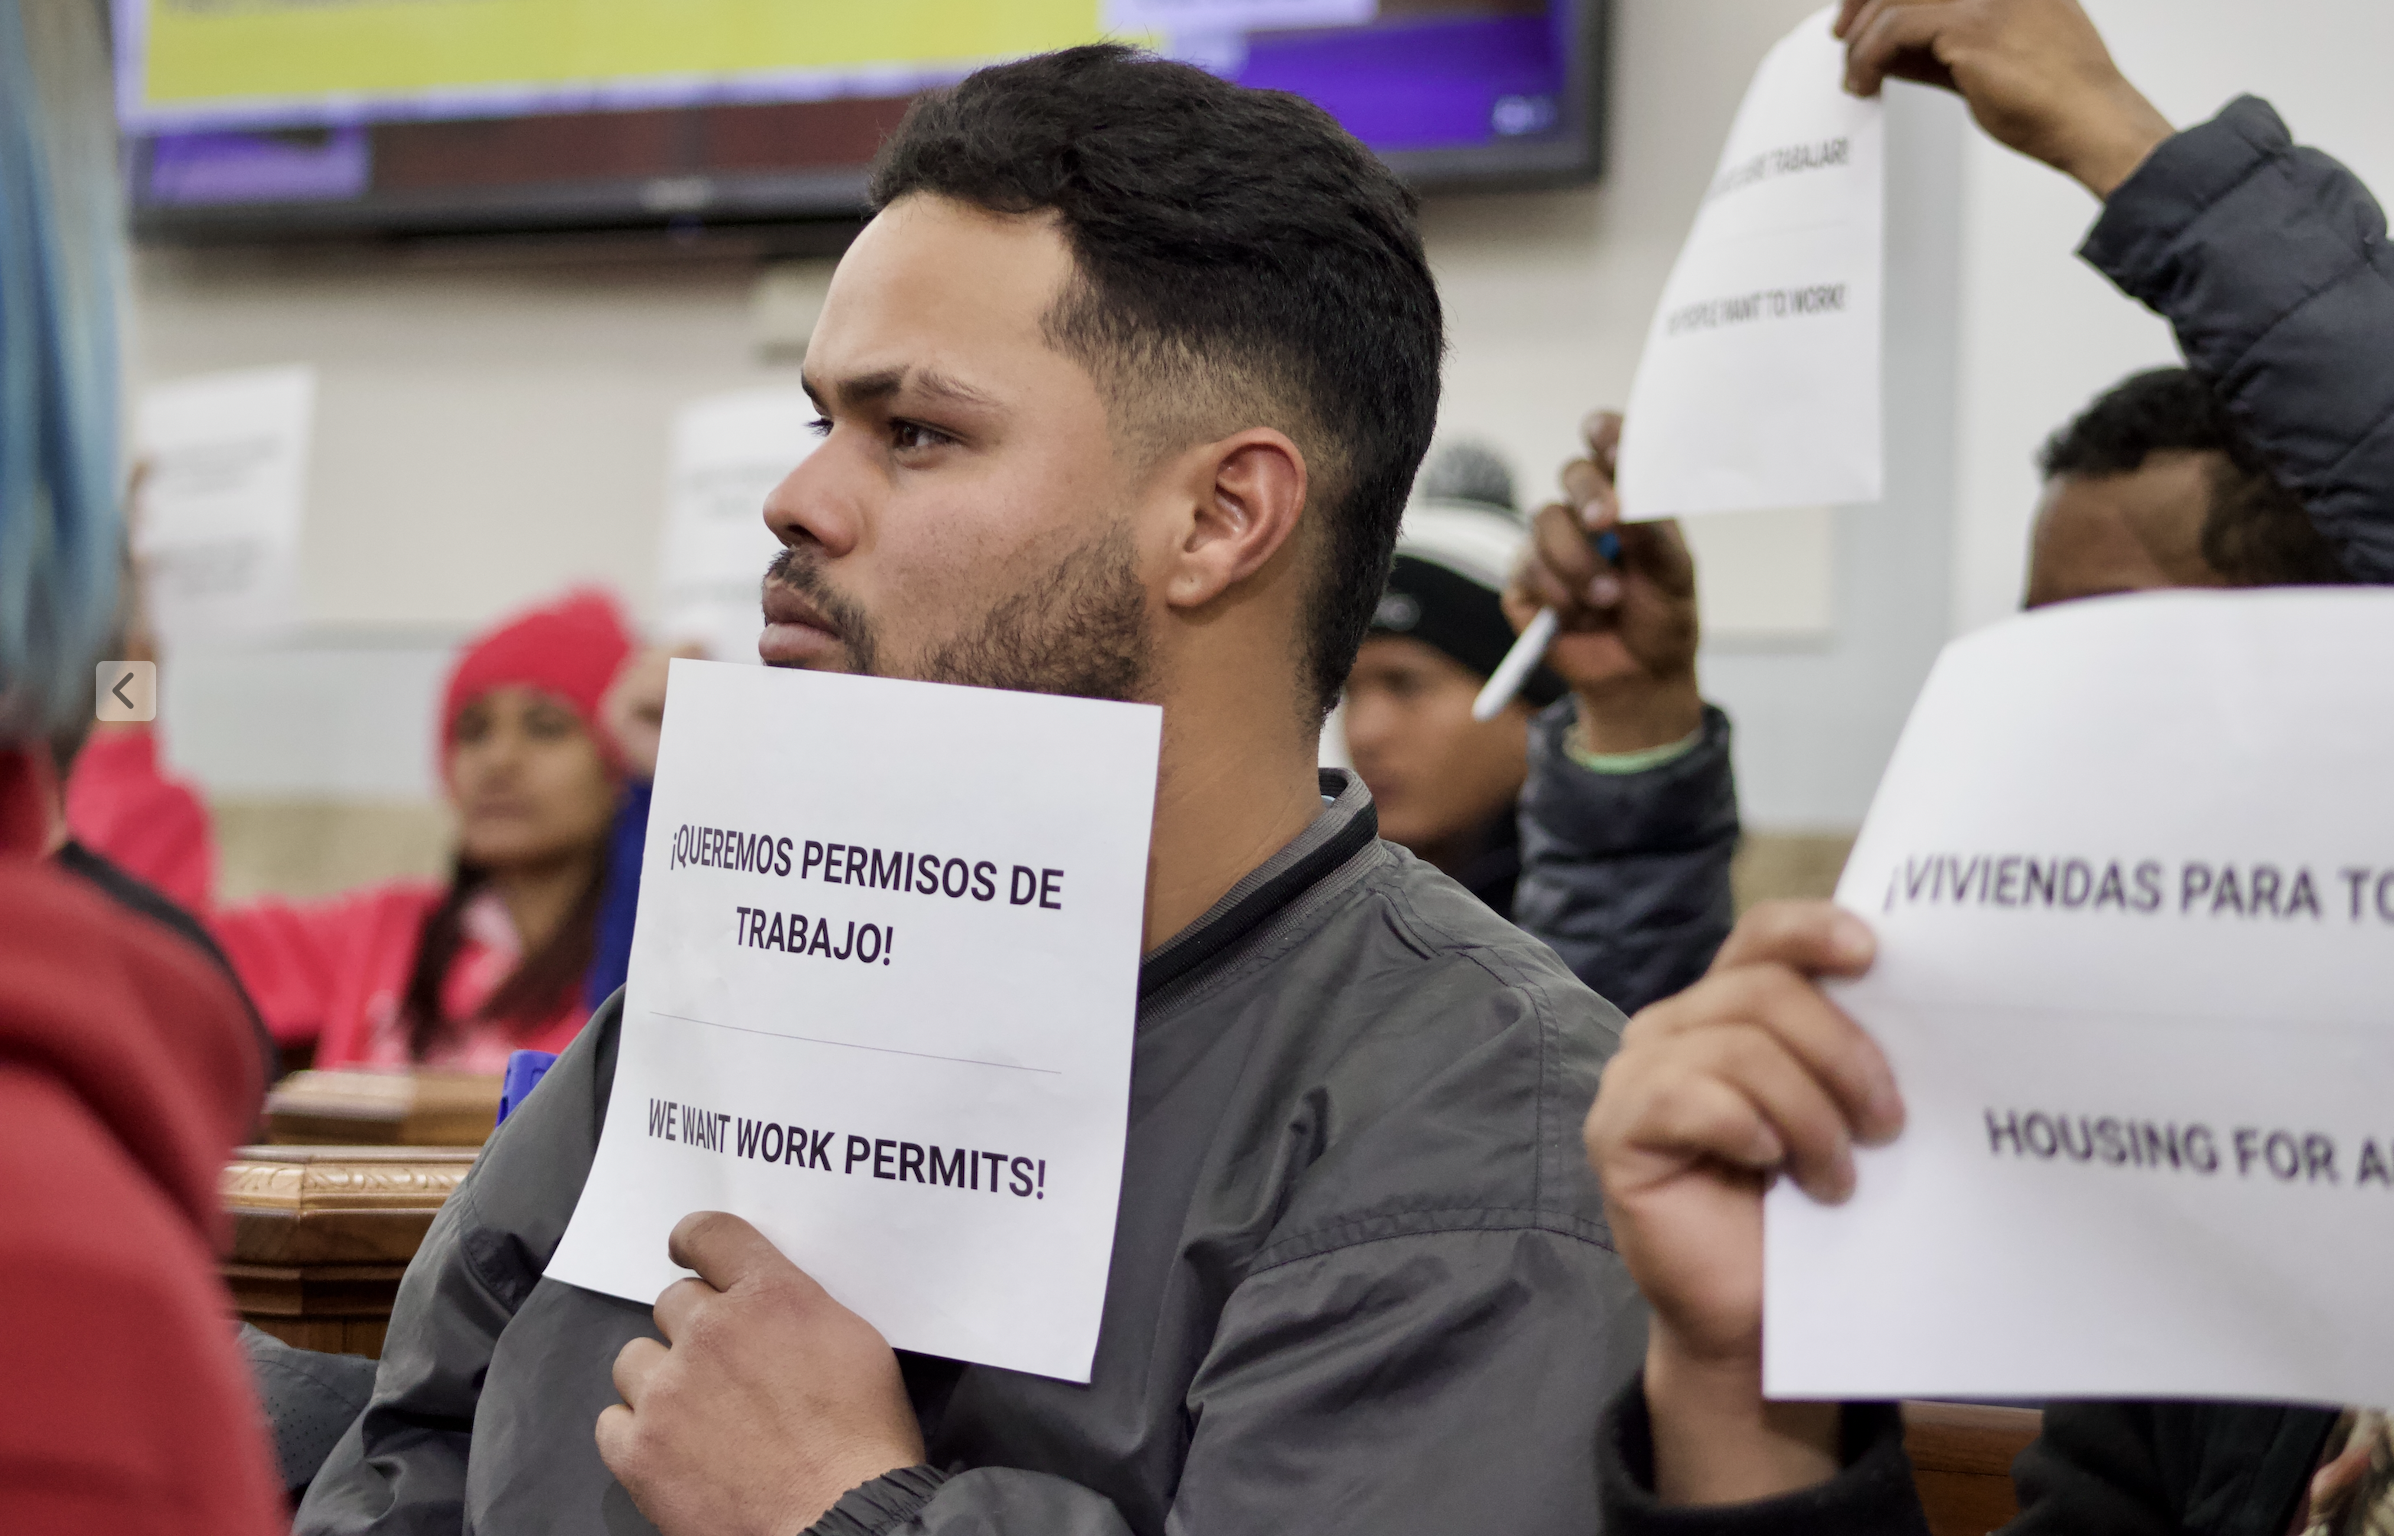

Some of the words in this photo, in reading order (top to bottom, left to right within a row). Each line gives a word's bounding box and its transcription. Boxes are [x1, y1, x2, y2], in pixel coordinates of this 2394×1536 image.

[669, 824, 794, 878] ¡QUEREMOS
[800, 840, 998, 902] PERMISOS
[1008, 865, 1065, 910] DE
[1881, 854, 2163, 917] ¡VIVIENDAS
[2178, 858, 2324, 922] PARA
[736, 906, 895, 967] TRABAJO!
[648, 1097, 679, 1142] WE
[681, 1104, 732, 1154] WANT
[736, 1117, 836, 1172] WORK
[844, 1134, 1047, 1200] PERMITS!
[1983, 1106, 2220, 1176] HOUSING
[2231, 1126, 2340, 1187] FOR
[2355, 1134, 2394, 1189] A
